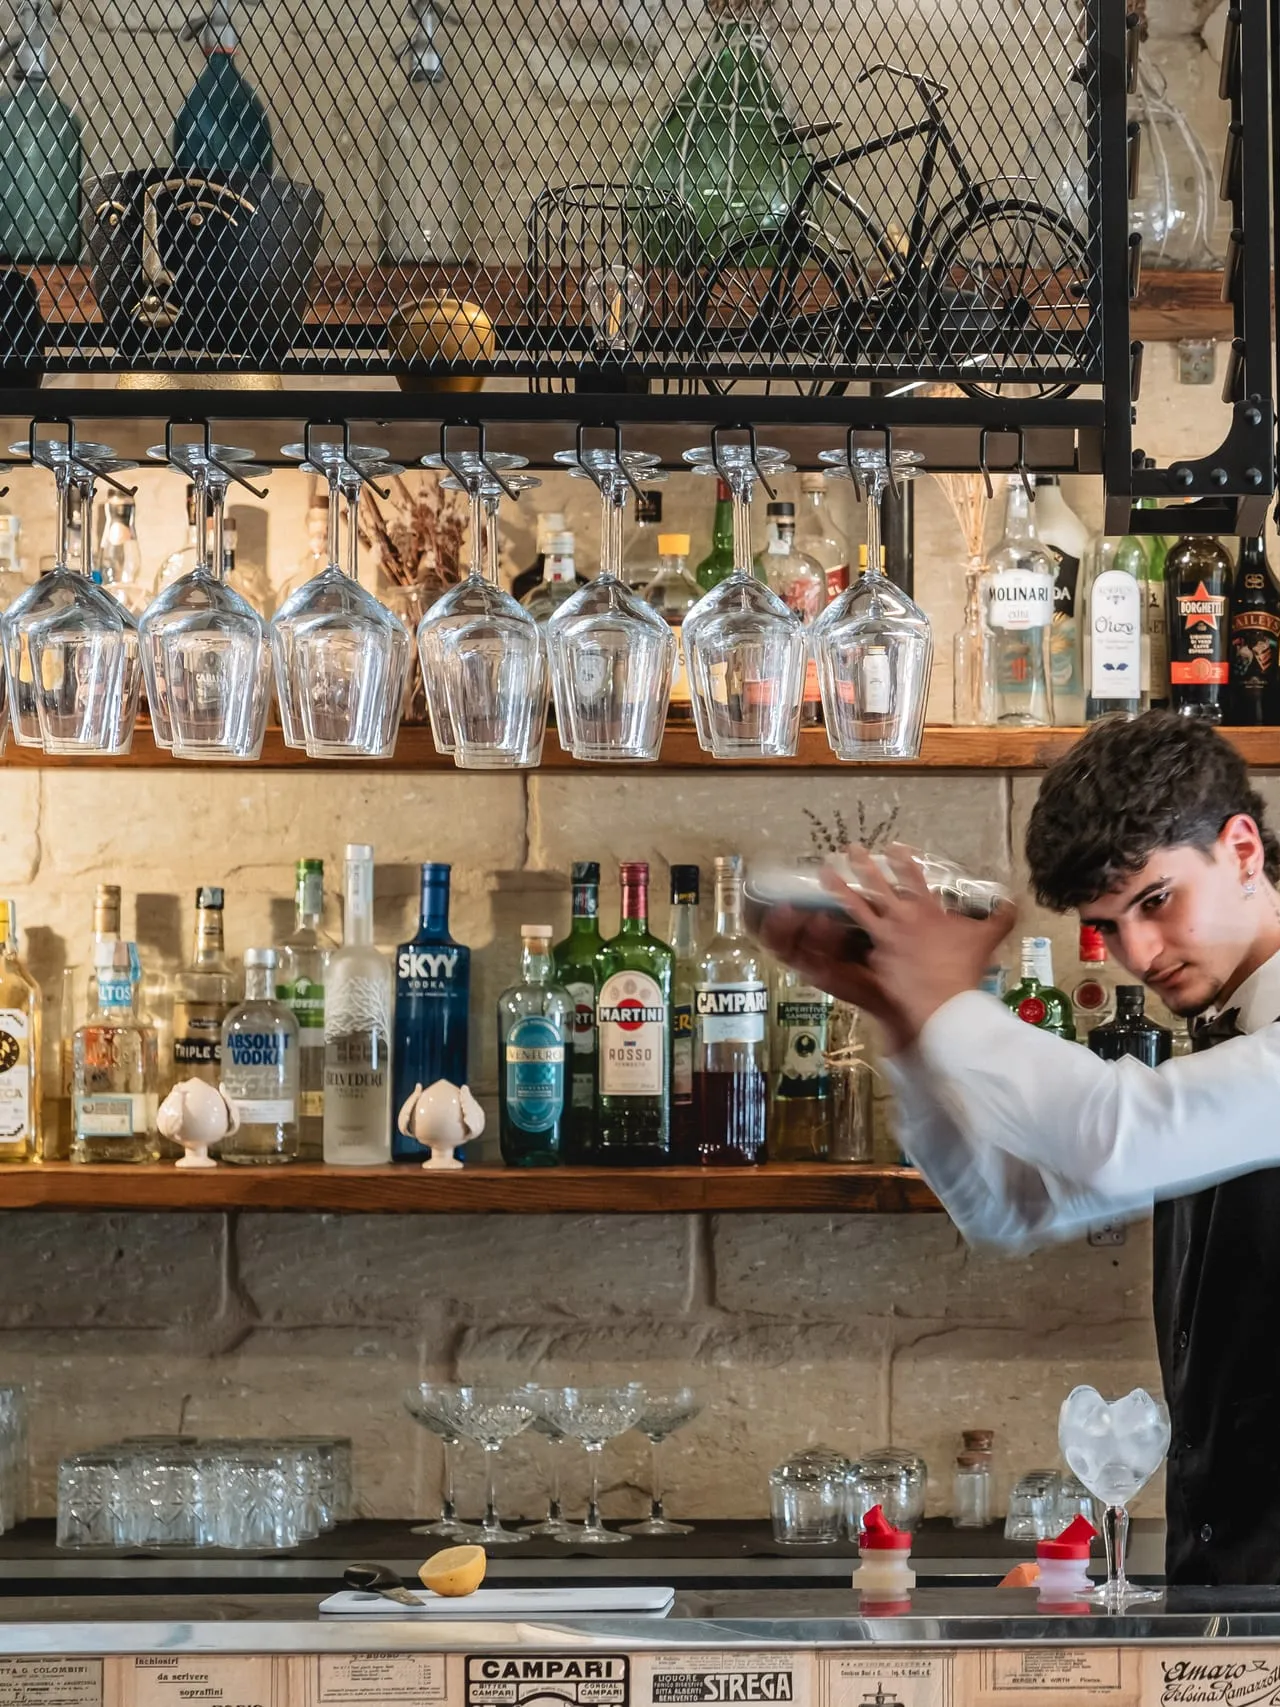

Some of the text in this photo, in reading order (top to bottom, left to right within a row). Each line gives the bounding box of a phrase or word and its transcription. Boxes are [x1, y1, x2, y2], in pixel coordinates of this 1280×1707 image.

[989, 586, 1049, 602] MOLINARI
[1180, 601, 1222, 614] BORGHETTI
[398, 952, 458, 979] SKYY
[408, 980, 445, 989] VODKA
[697, 991, 768, 1013] CAMPARI
[600, 1007, 663, 1022] MARTINI
[227, 1032, 290, 1049] ABSOLUT
[174, 1044, 212, 1058] TRIPLE
[231, 1050, 283, 1065] VODKA
[608, 1048, 652, 1061] ROSSO
[157, 1672, 209, 1681] da scrivere
[481, 1661, 613, 1679] CAMPARI
[1161, 1660, 1248, 1683] Amaro
[658, 1674, 698, 1683] LIQUORE
[179, 1688, 223, 1697] sopraffini
[674, 1687, 702, 1695] ALBERTI
[703, 1673, 791, 1701] STREGA
